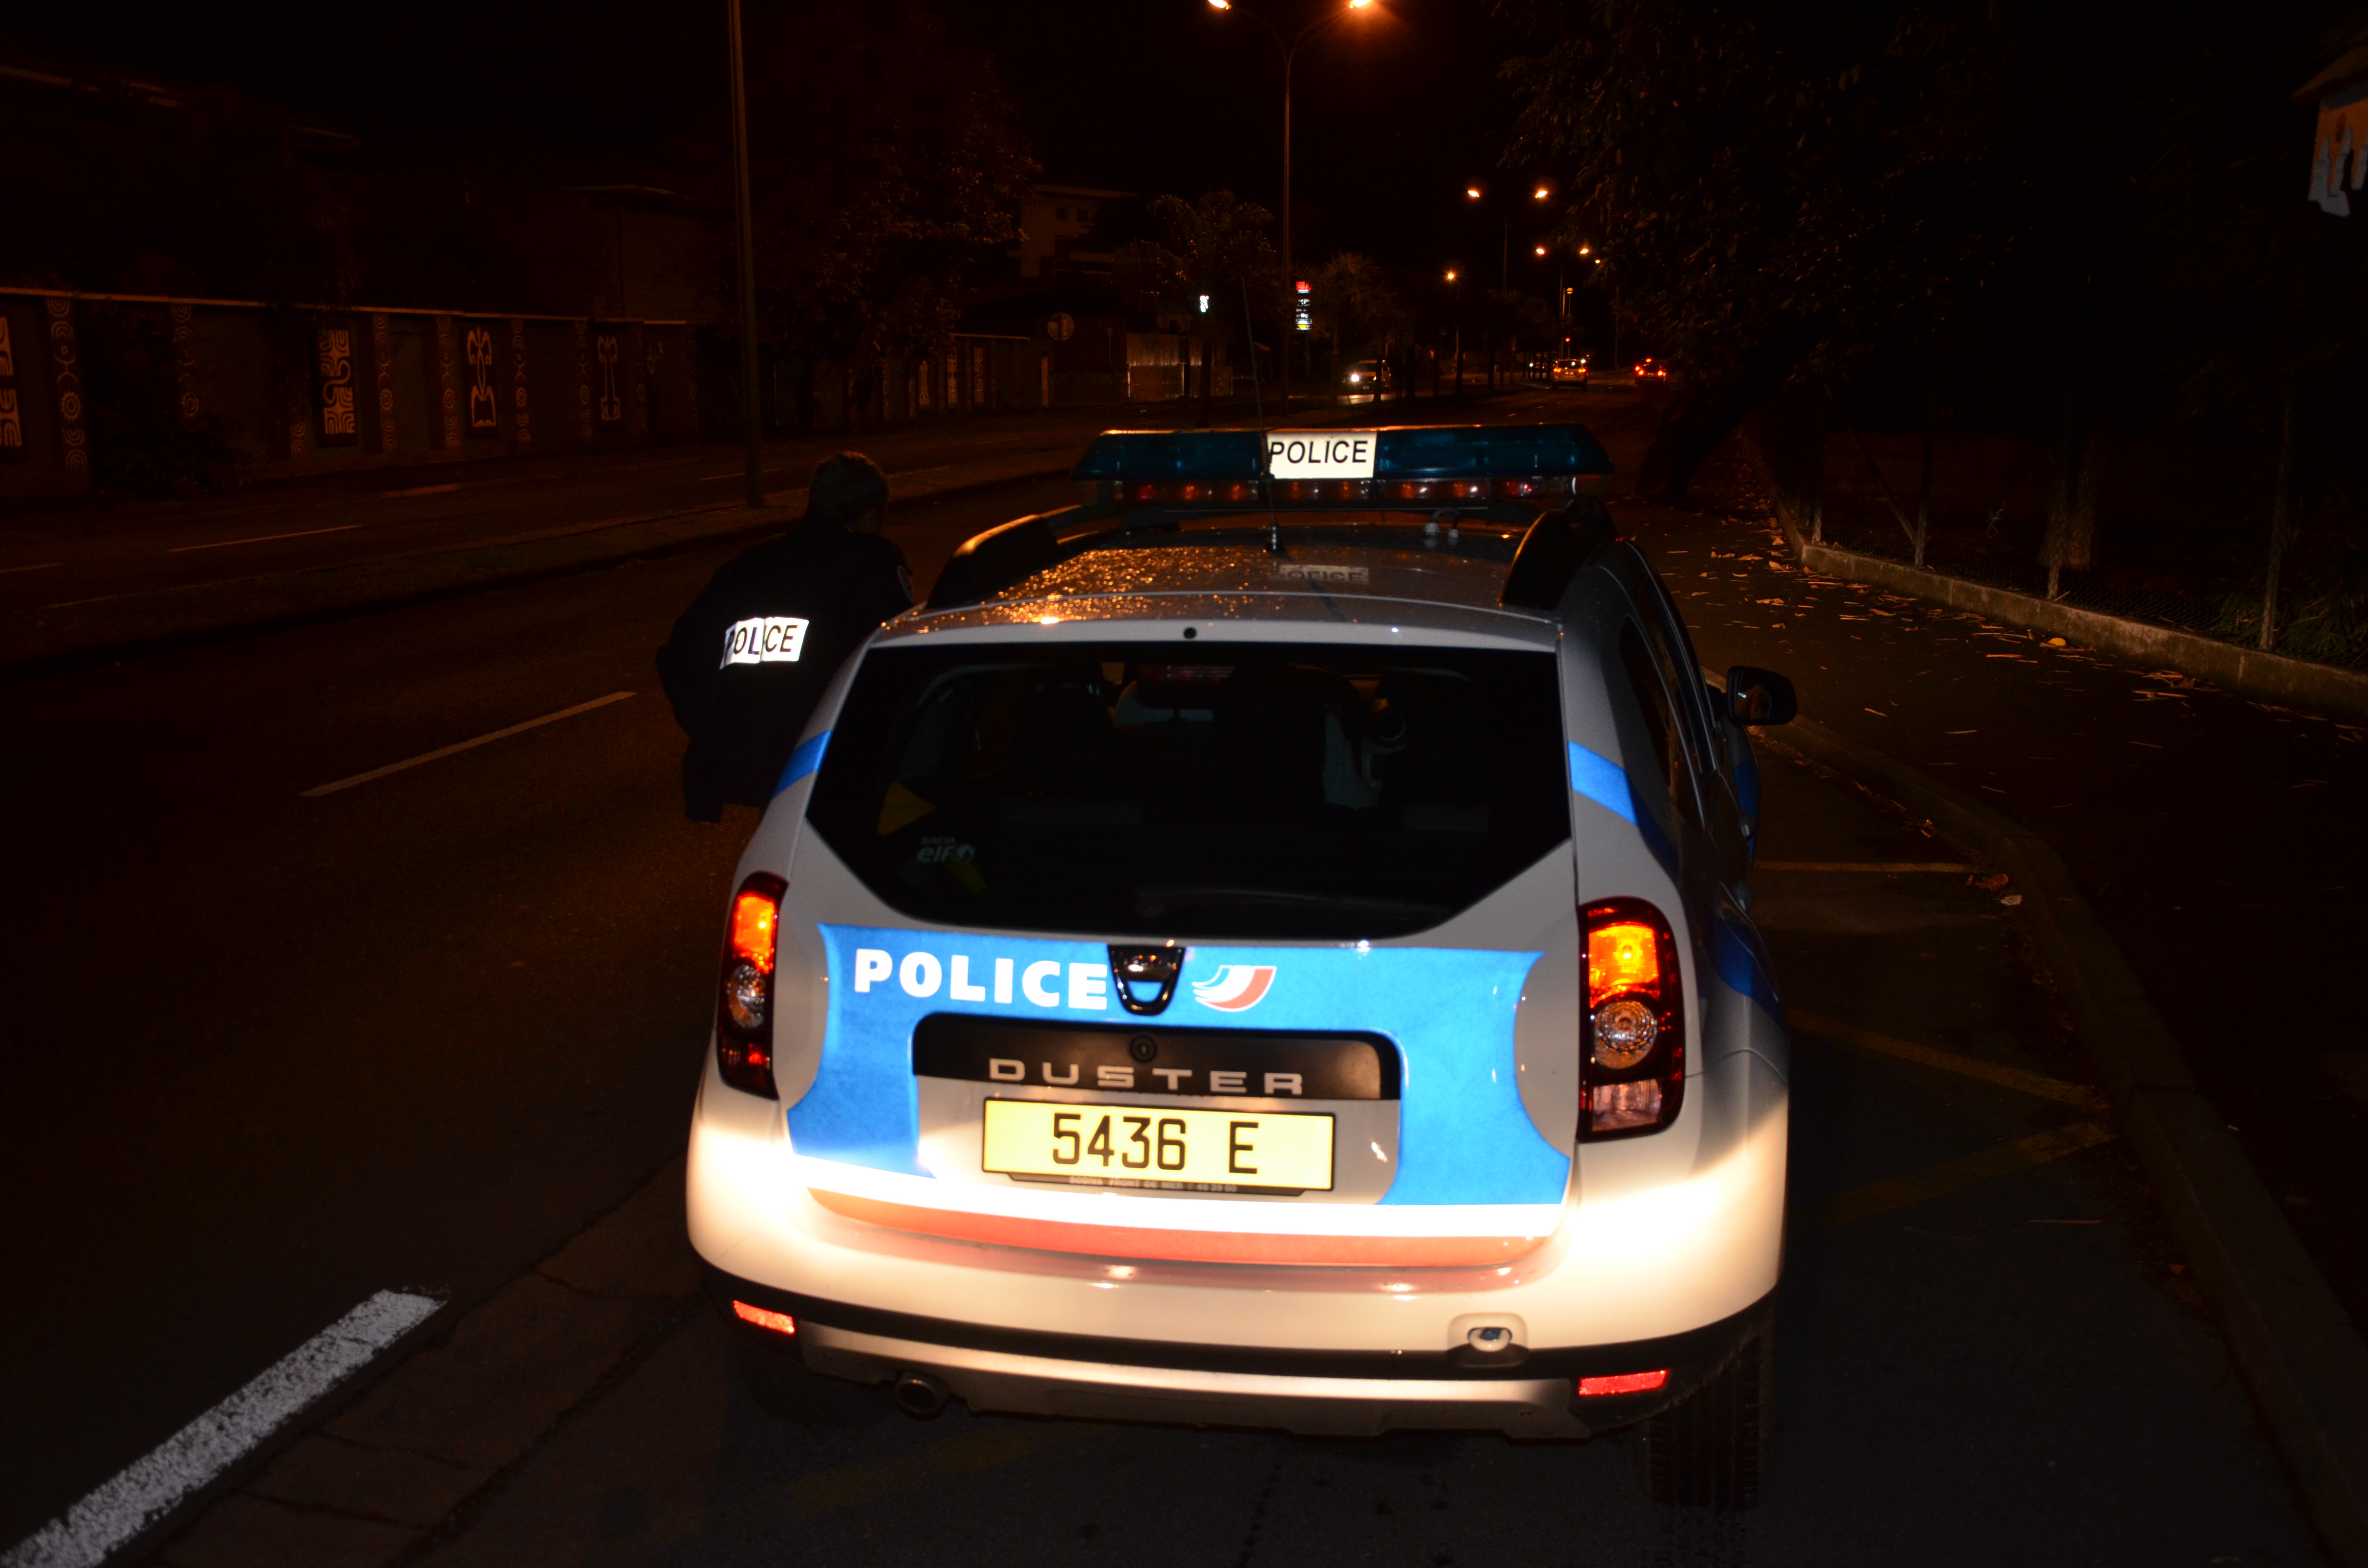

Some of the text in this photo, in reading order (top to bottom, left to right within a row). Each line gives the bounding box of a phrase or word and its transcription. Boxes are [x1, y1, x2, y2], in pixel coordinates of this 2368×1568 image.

[1270, 440, 1368, 464] POLICE
[854, 948, 1107, 1010] POLICE
[989, 1058, 1303, 1095] DUSTER
[1053, 1112, 1259, 1175] 5436 E
